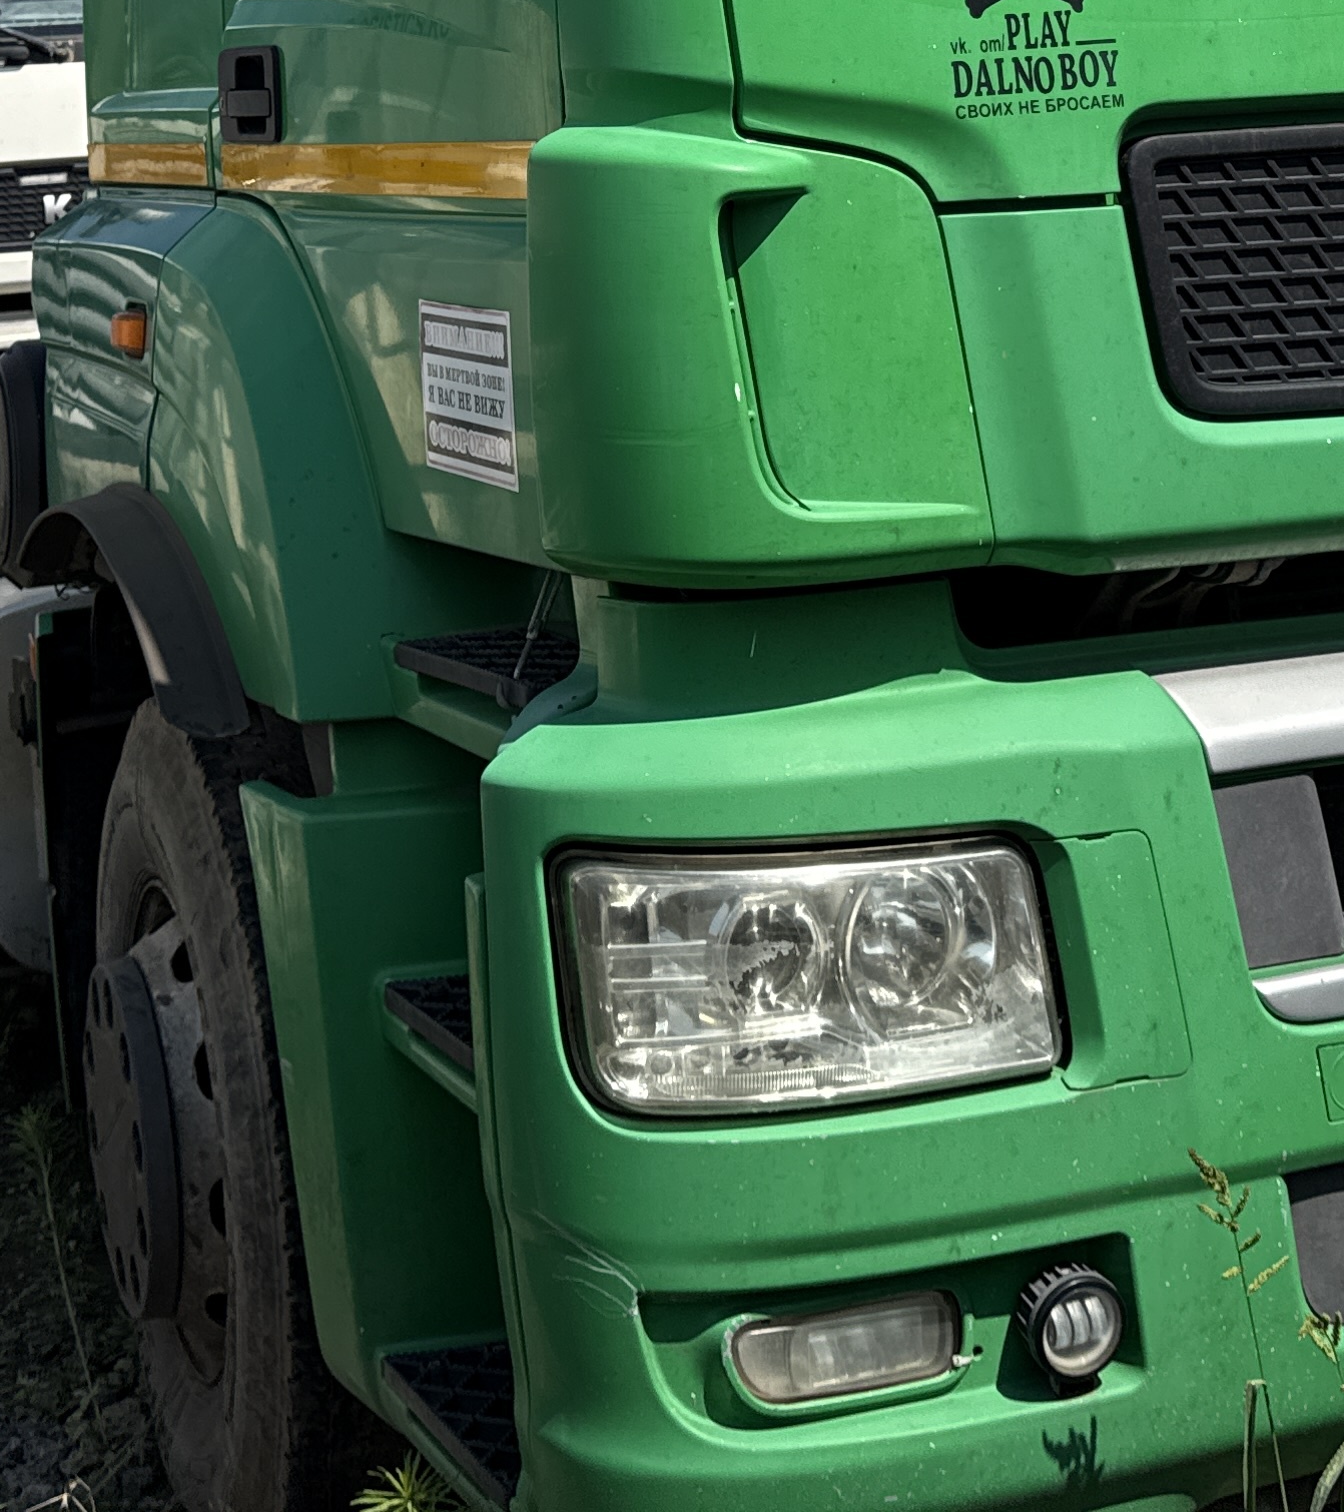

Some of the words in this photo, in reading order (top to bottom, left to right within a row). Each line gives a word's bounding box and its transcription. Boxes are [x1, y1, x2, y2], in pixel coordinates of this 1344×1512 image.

[955, 102, 1014, 120] СВОИХ
[1018, 99, 1041, 115] НЕ
[1045, 94, 1125, 113] БРОСАЕМ
[427, 362, 438, 378] ВЫ
[439, 365, 445, 380] В
[446, 366, 481, 387] МЕРТВОЙ
[428, 384, 436, 404] Я
[437, 386, 456, 408] ВАС
[457, 390, 473, 412] НЕ
[474, 394, 506, 420] ВИЖУ
[428, 420, 512, 467] ОСТОРОЖНО!
